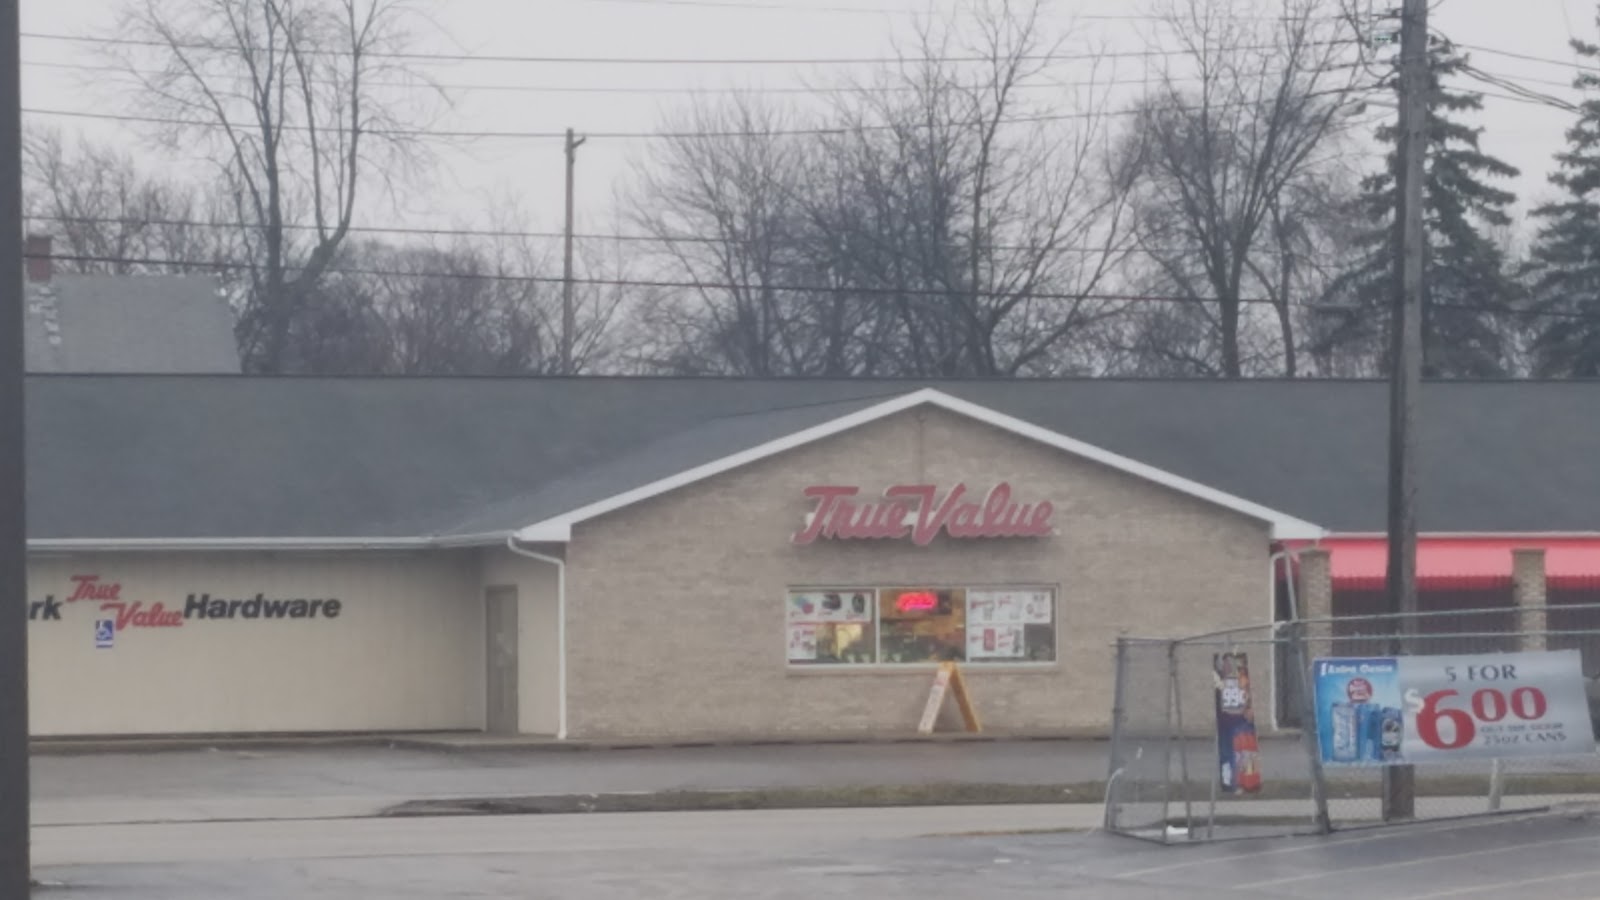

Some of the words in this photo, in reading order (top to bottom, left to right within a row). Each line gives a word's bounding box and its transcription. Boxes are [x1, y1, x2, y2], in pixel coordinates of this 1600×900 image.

[791, 485, 911, 545] True
[884, 481, 1055, 546] Value
[66, 574, 121, 602] True
[29, 594, 62, 620] rk
[100, 601, 184, 630] Value
[184, 593, 341, 619] Hardware
[1444, 666, 1457, 682] 5
[1467, 664, 1517, 681] FOR
[1524, 731, 1568, 743] CANS
